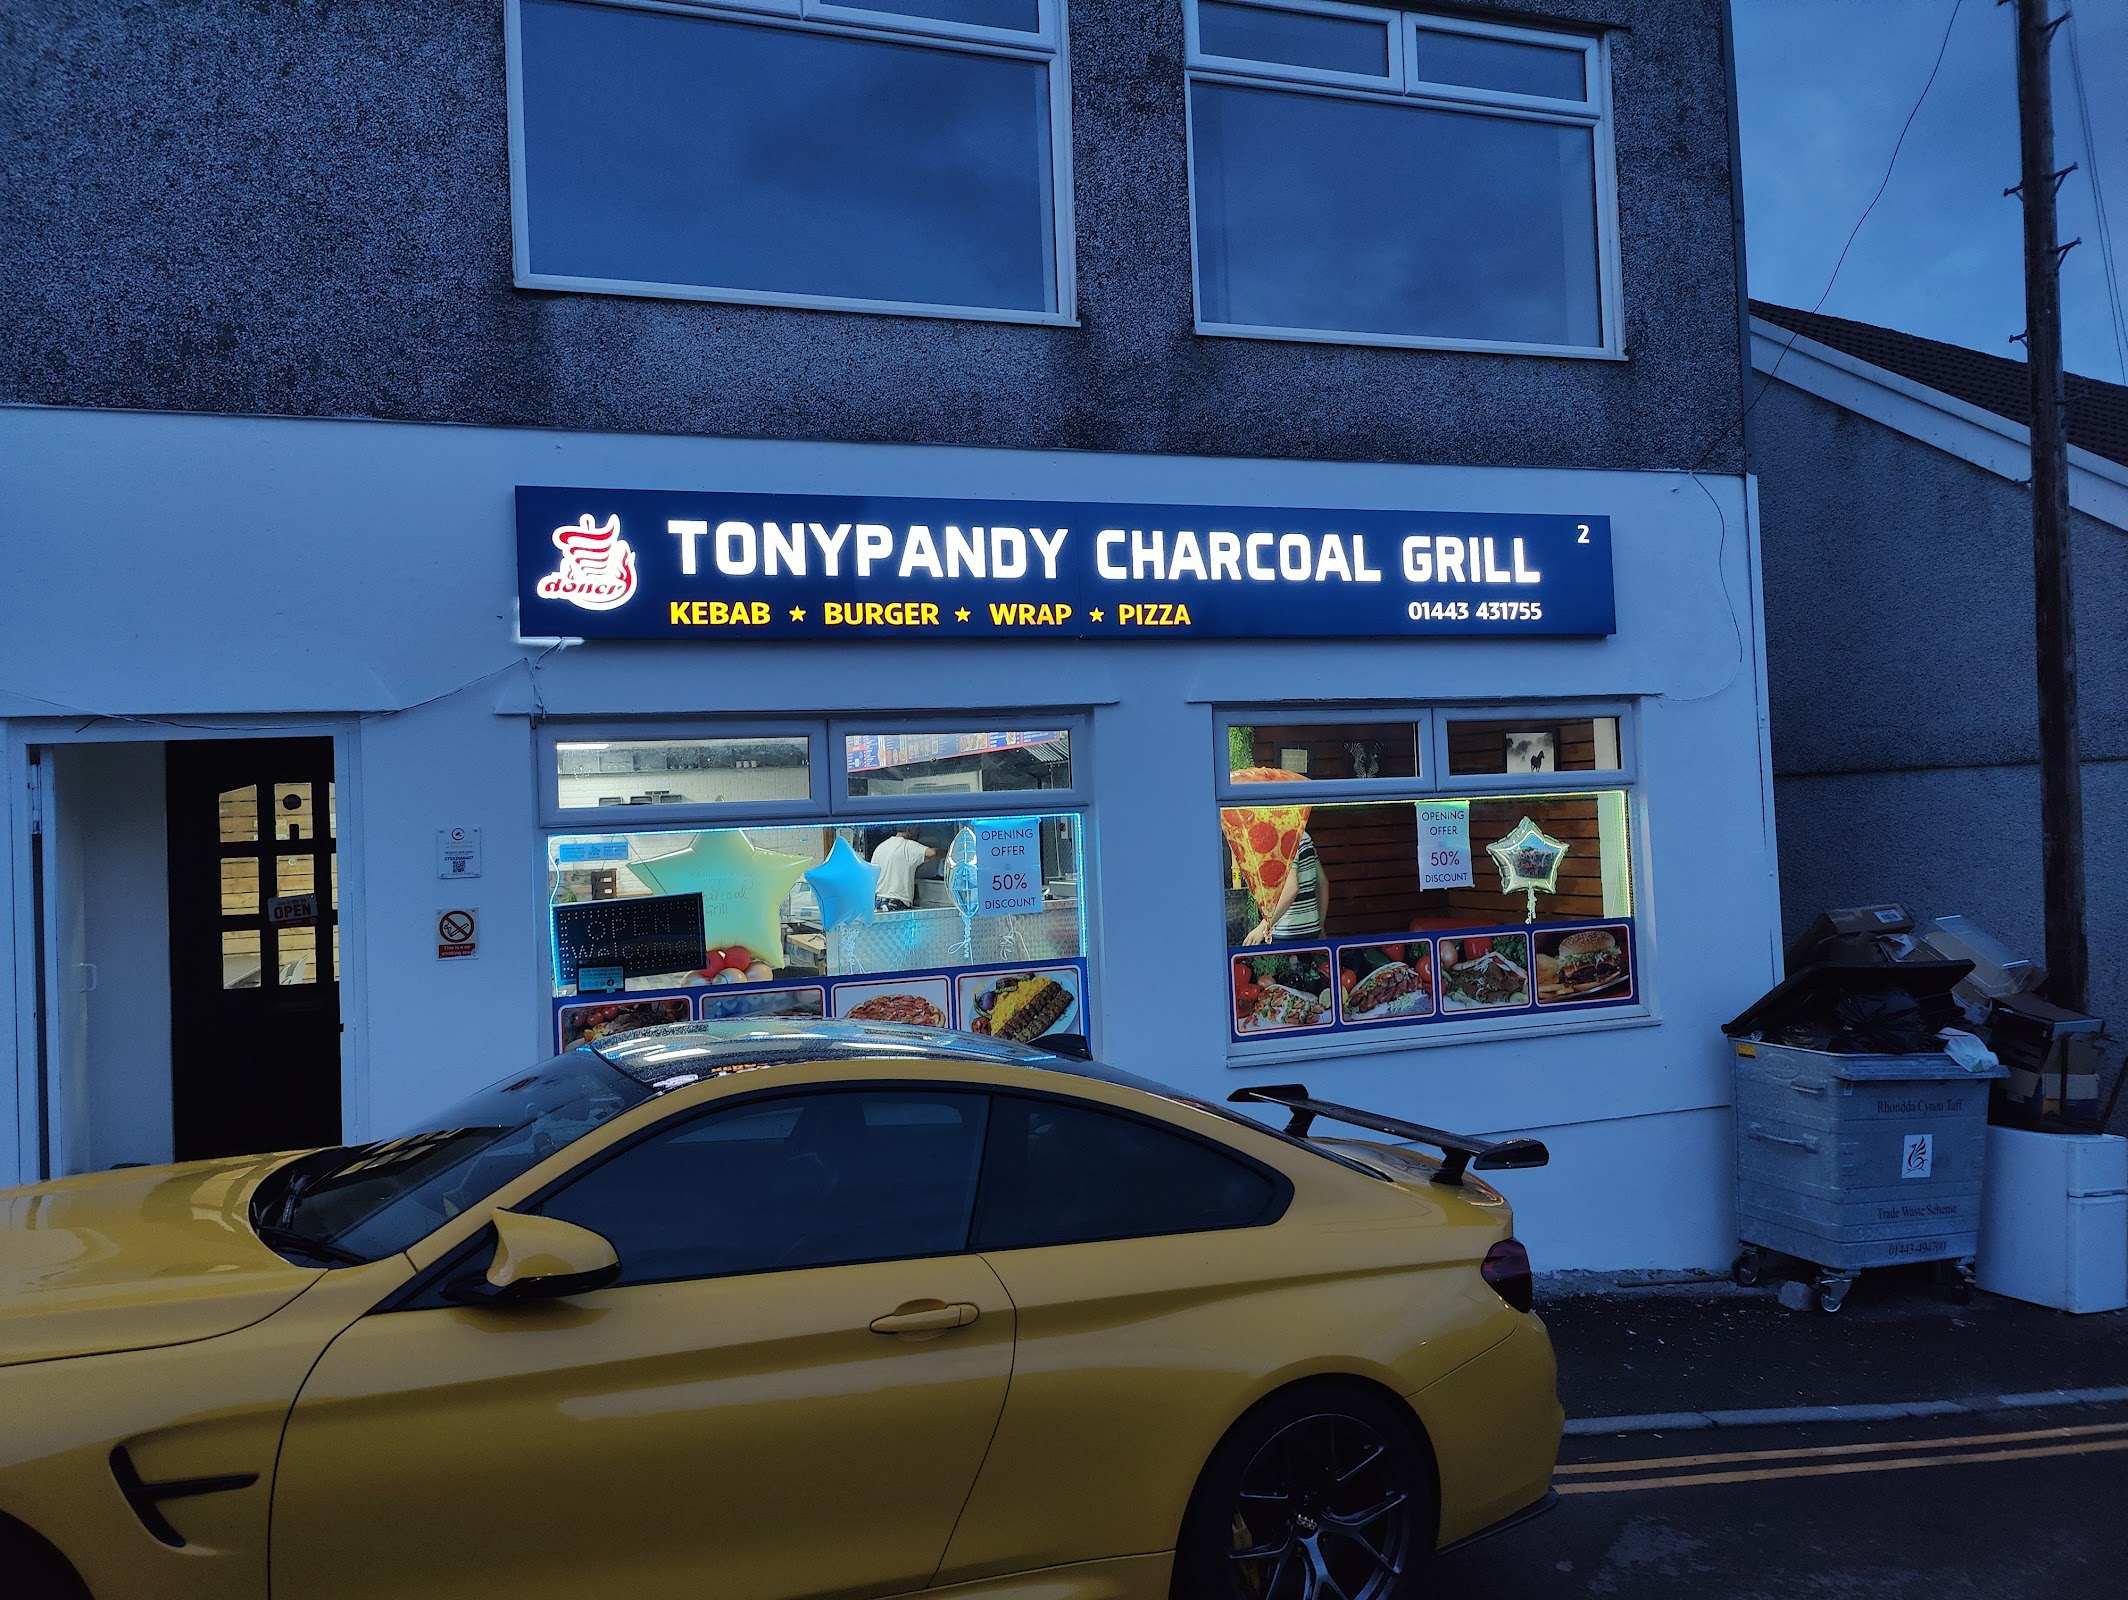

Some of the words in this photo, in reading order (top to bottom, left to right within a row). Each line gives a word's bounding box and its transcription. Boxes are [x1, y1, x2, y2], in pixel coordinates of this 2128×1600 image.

[1577, 524, 1590, 544] 2
[667, 520, 1069, 579] TONYPANDY
[1096, 529, 1381, 583] CHARCOAL
[1402, 536, 1541, 584] GRILL
[670, 602, 771, 626] KEBAB
[824, 603, 940, 626] BURGER
[988, 603, 1073, 626] WRAP
[1118, 604, 1192, 626] PIZZA
[1408, 602, 1469, 621] 01443
[1475, 602, 1543, 621] 431755
[1421, 810, 1465, 821] OPENING
[981, 828, 1033, 841] OPENING
[1429, 826, 1458, 836] OFFER
[990, 845, 1025, 857] OFFER
[1430, 850, 1460, 867] 50%
[992, 873, 1028, 891] 50%
[1425, 872, 1468, 883] DISCOUNT
[273, 903, 312, 919] OPEN
[985, 897, 1037, 910] DISCOUNT
[588, 914, 671, 940] OPEN
[1877, 1100, 1915, 1113] Rhondda
[1877, 1206, 1899, 1219] Trade
[1902, 1205, 1925, 1217] Waste
[1926, 1203, 1957, 1216] Scheme
